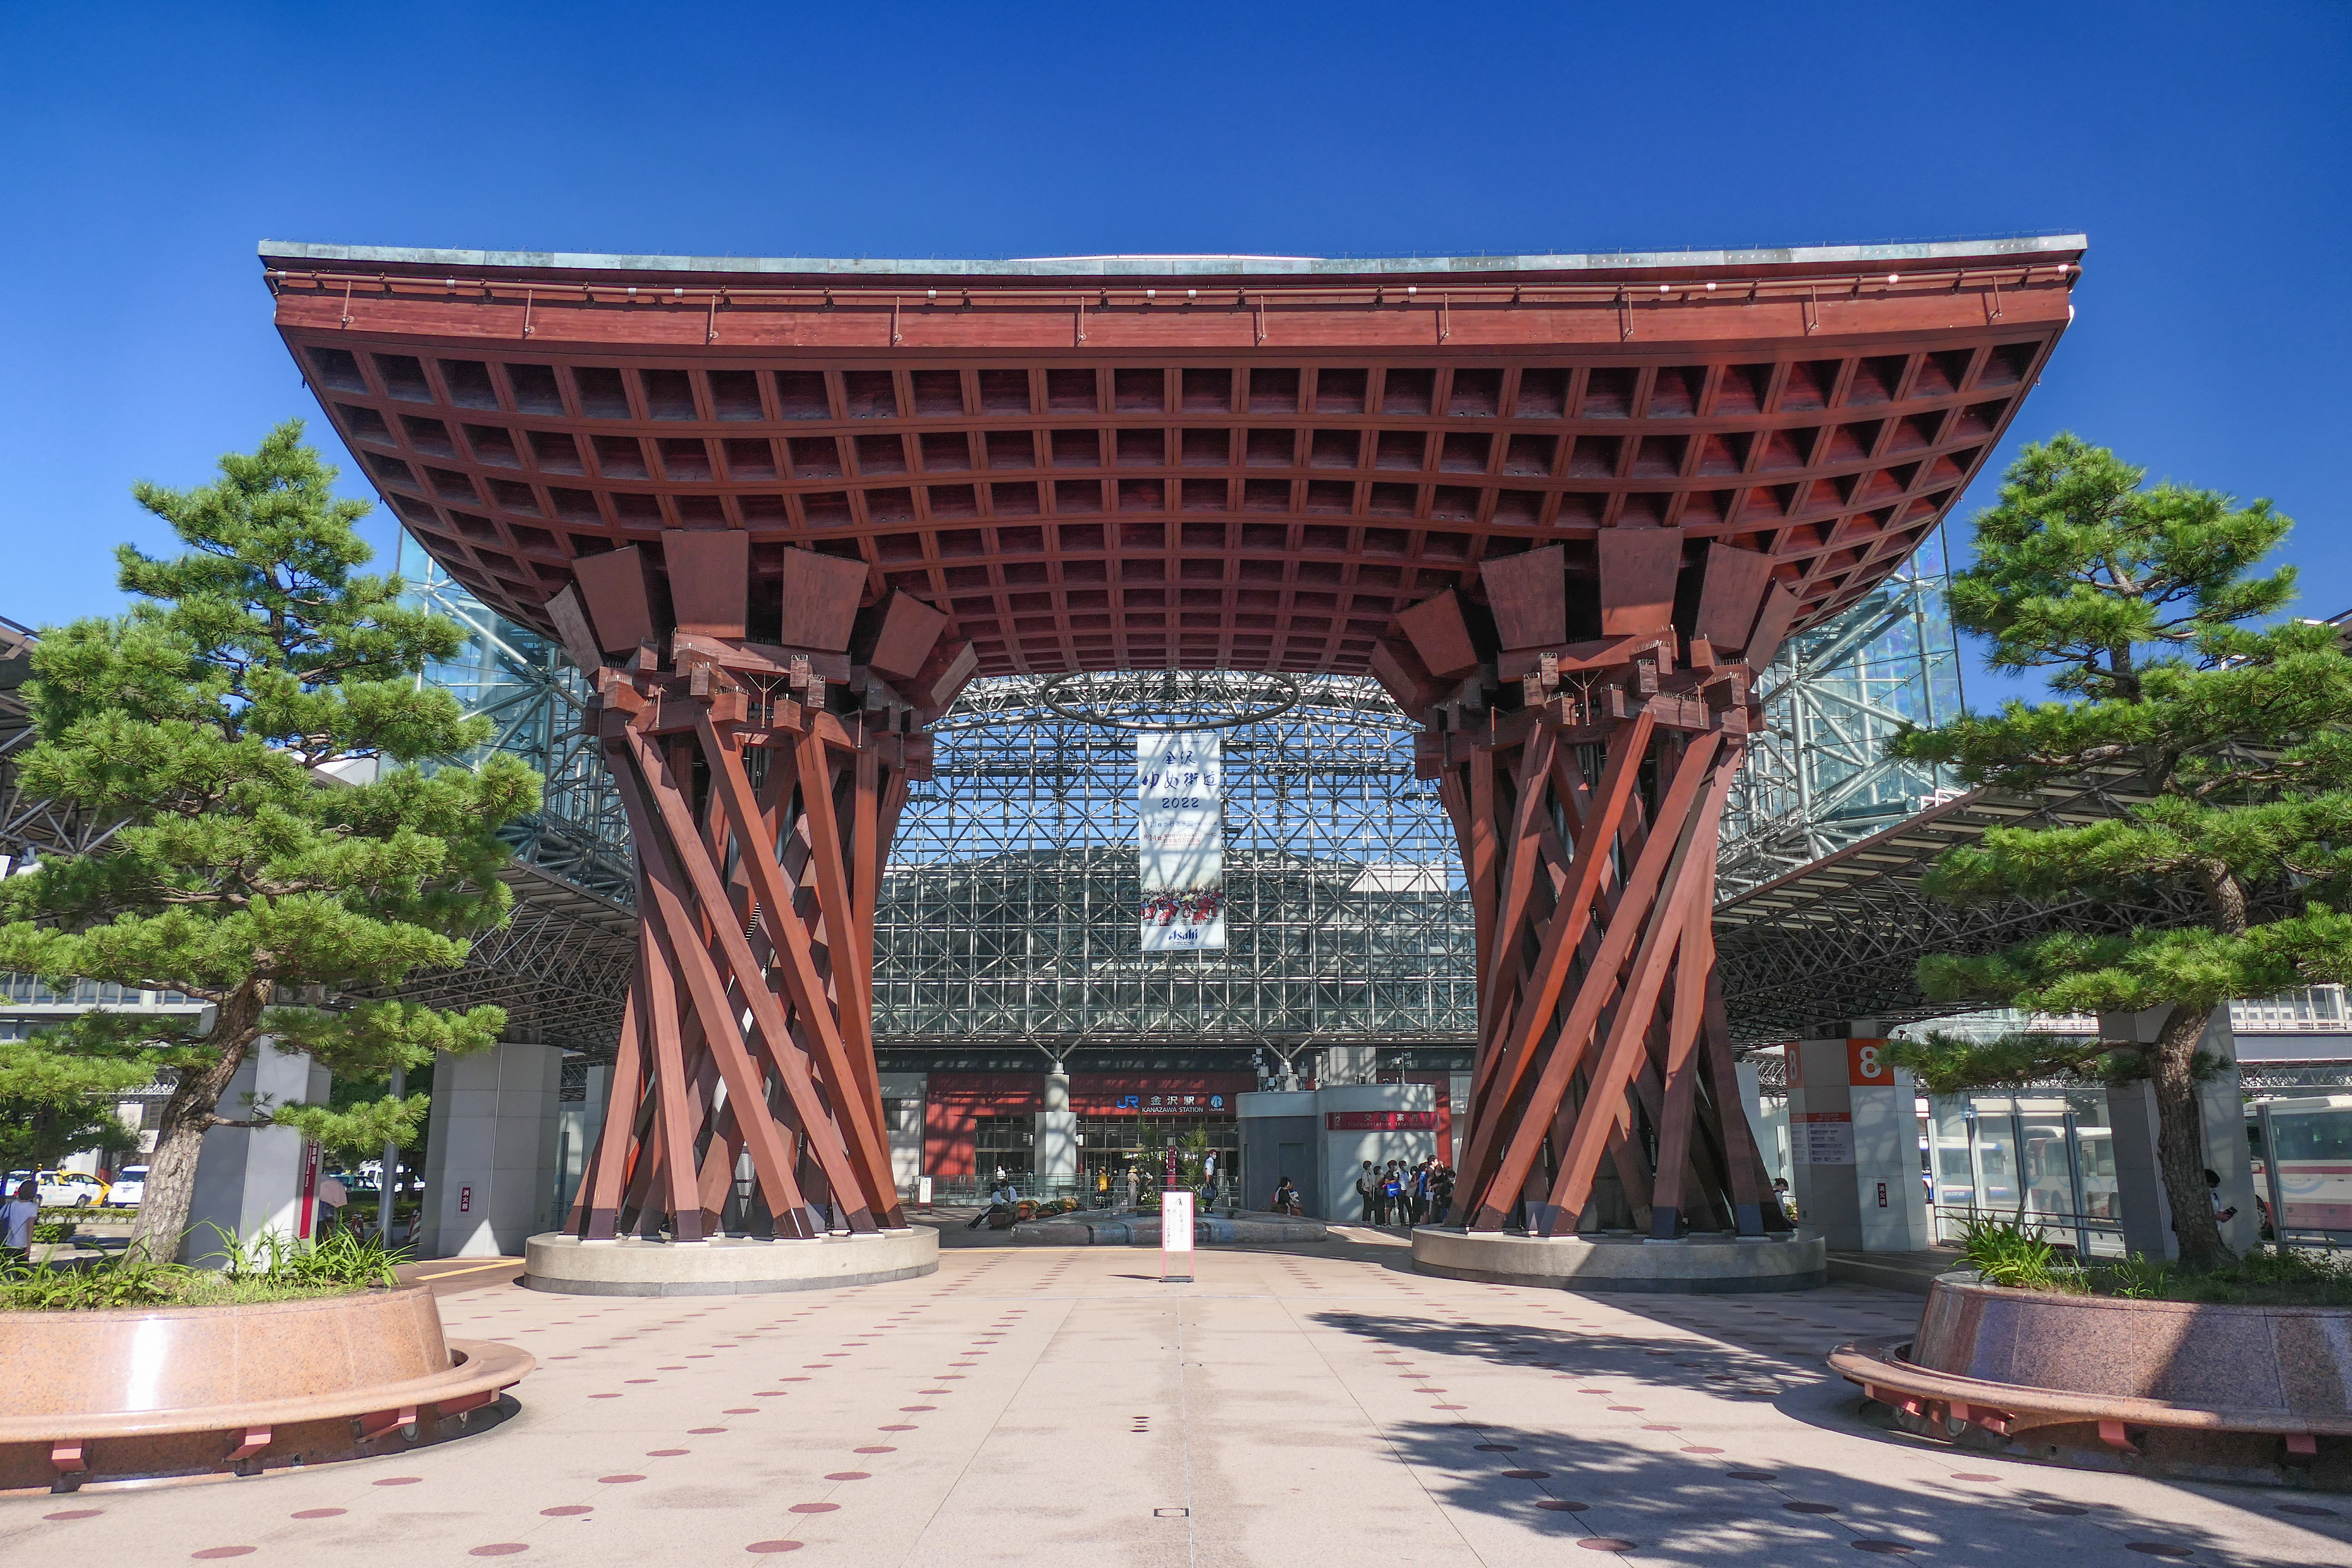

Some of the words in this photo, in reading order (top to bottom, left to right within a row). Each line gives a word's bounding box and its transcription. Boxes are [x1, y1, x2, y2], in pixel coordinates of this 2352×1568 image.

[1162, 750, 1196, 765] 金沢
[1142, 770, 1218, 790] ゆめ街道
[1162, 797, 1199, 808] 2022
[1168, 928, 1198, 940] Asahi
[1788, 1050, 1798, 1080] 8
[1860, 1046, 1882, 1078] 8
[1117, 1095, 1139, 1109] JR
[1150, 1095, 1195, 1106] 金沢駅
[1364, 1113, 1430, 1122] 交通案内所
